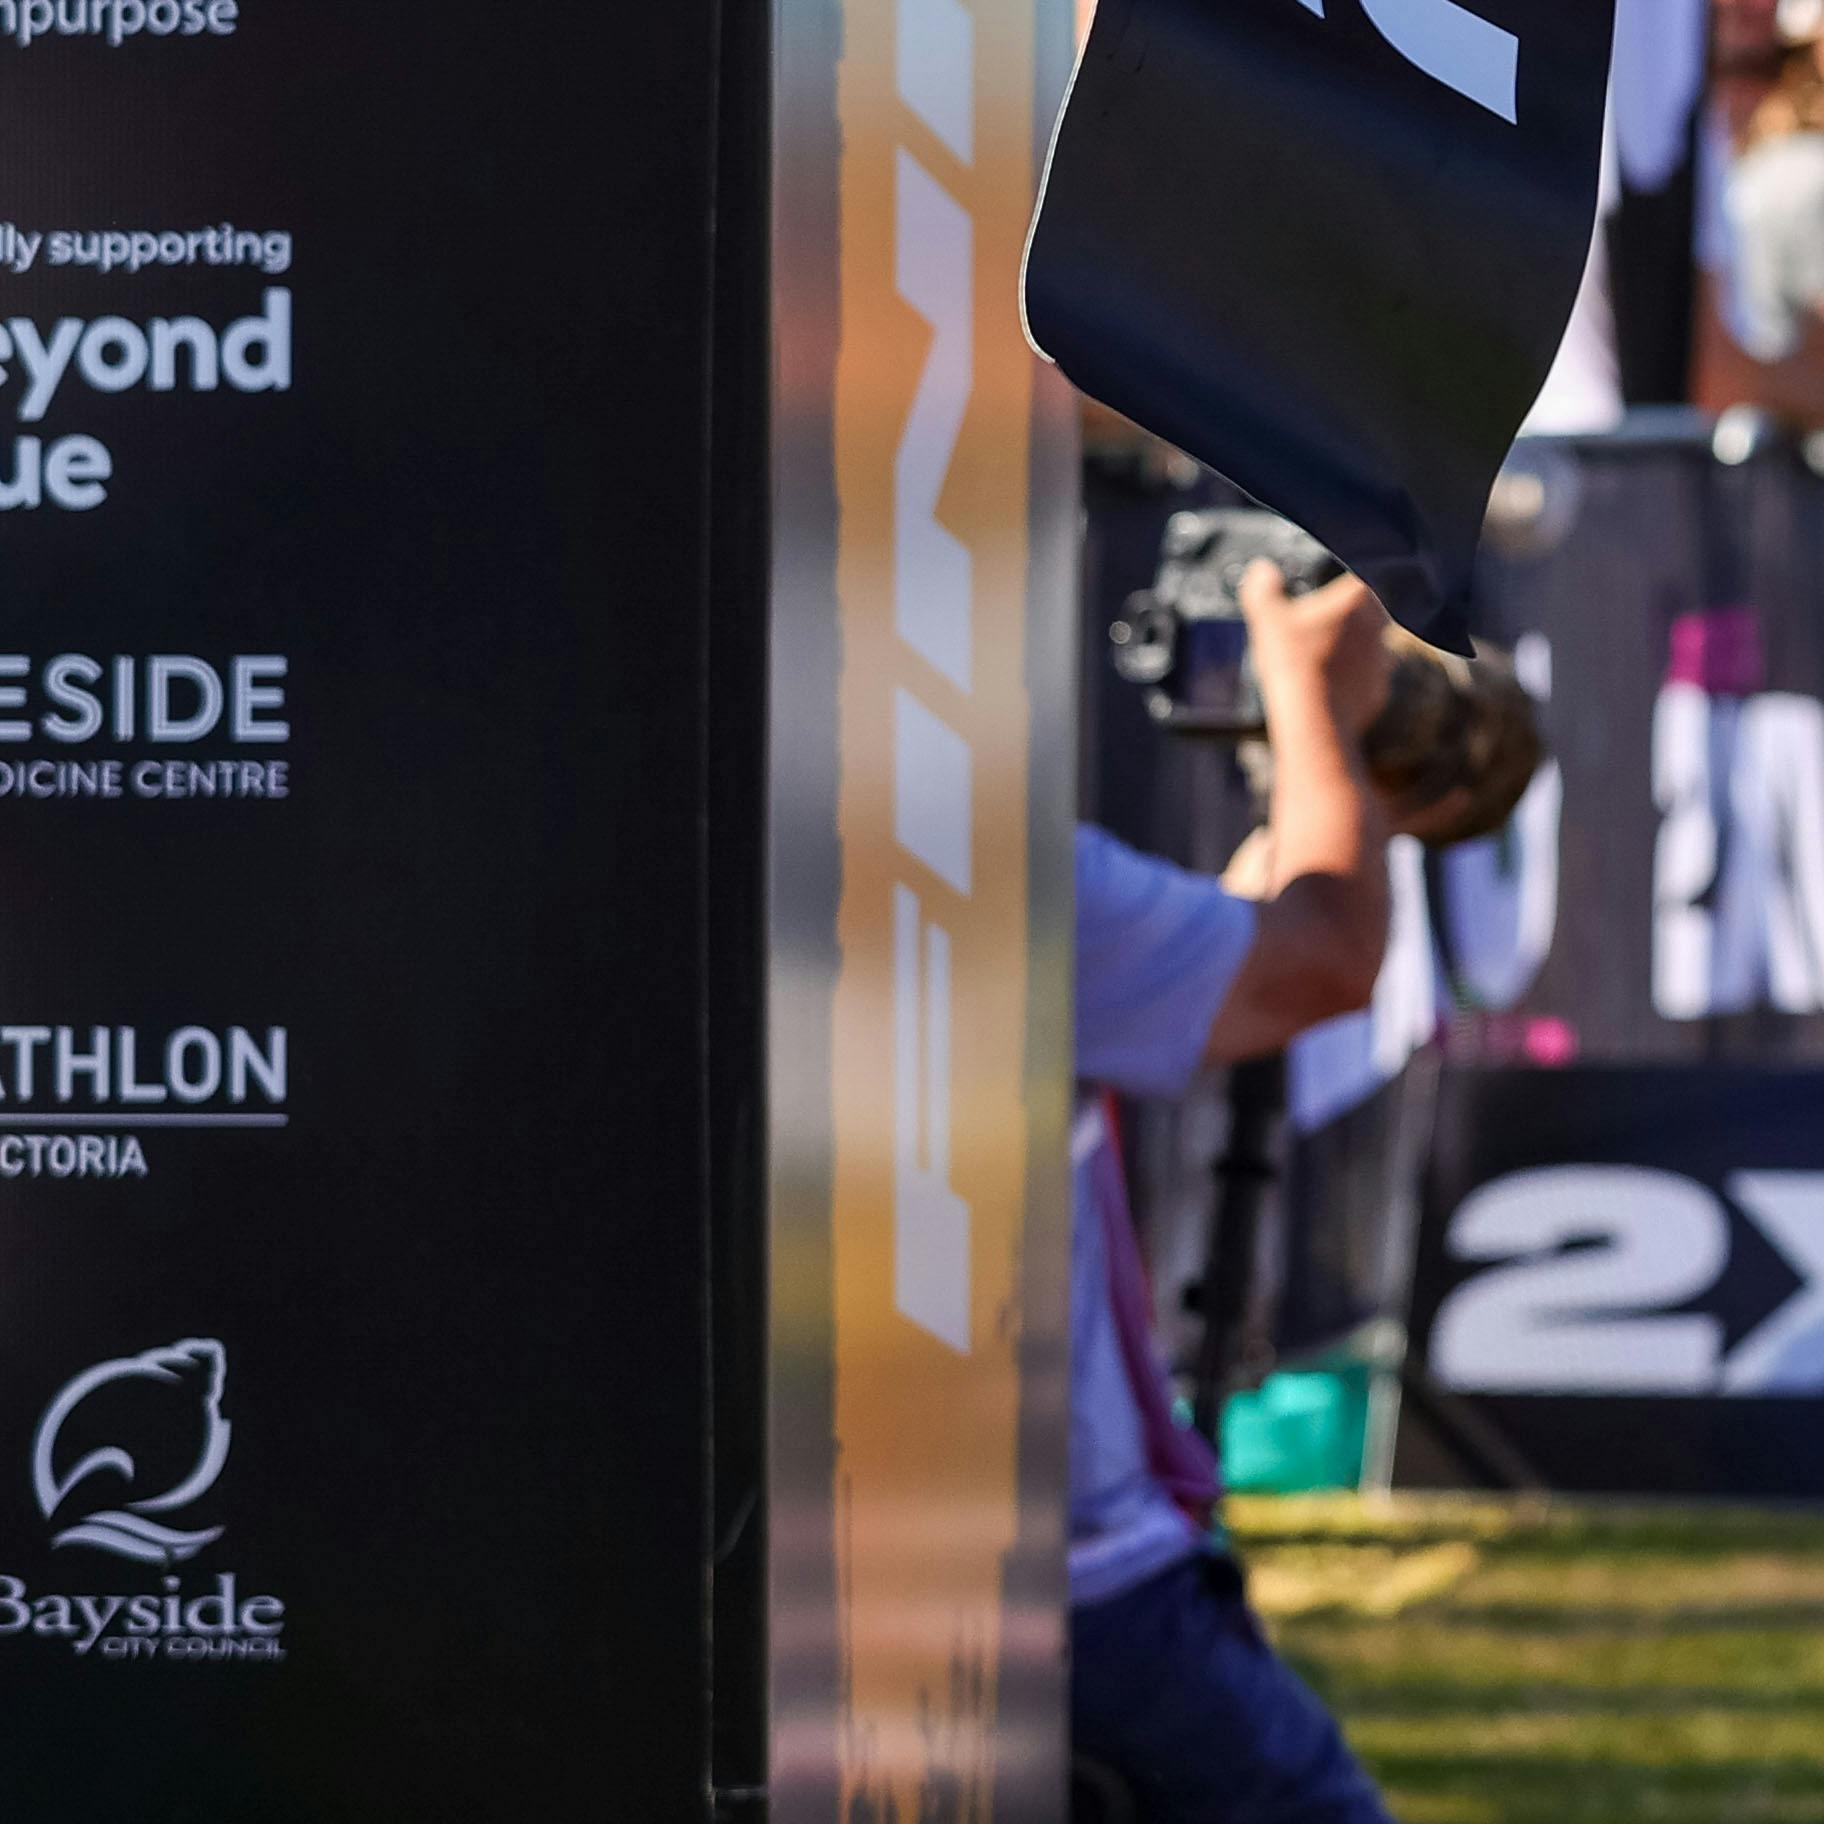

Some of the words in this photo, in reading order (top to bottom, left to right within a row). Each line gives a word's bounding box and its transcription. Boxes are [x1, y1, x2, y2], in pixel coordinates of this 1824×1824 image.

[47, 222, 292, 275] supporting
[0, 286, 292, 421] yond
[132, 759, 290, 798] CENTRE
[0, 1026, 288, 1103] THLON
[102, 1636, 158, 1658] CITY
[166, 1636, 286, 1658] COUNCIL
